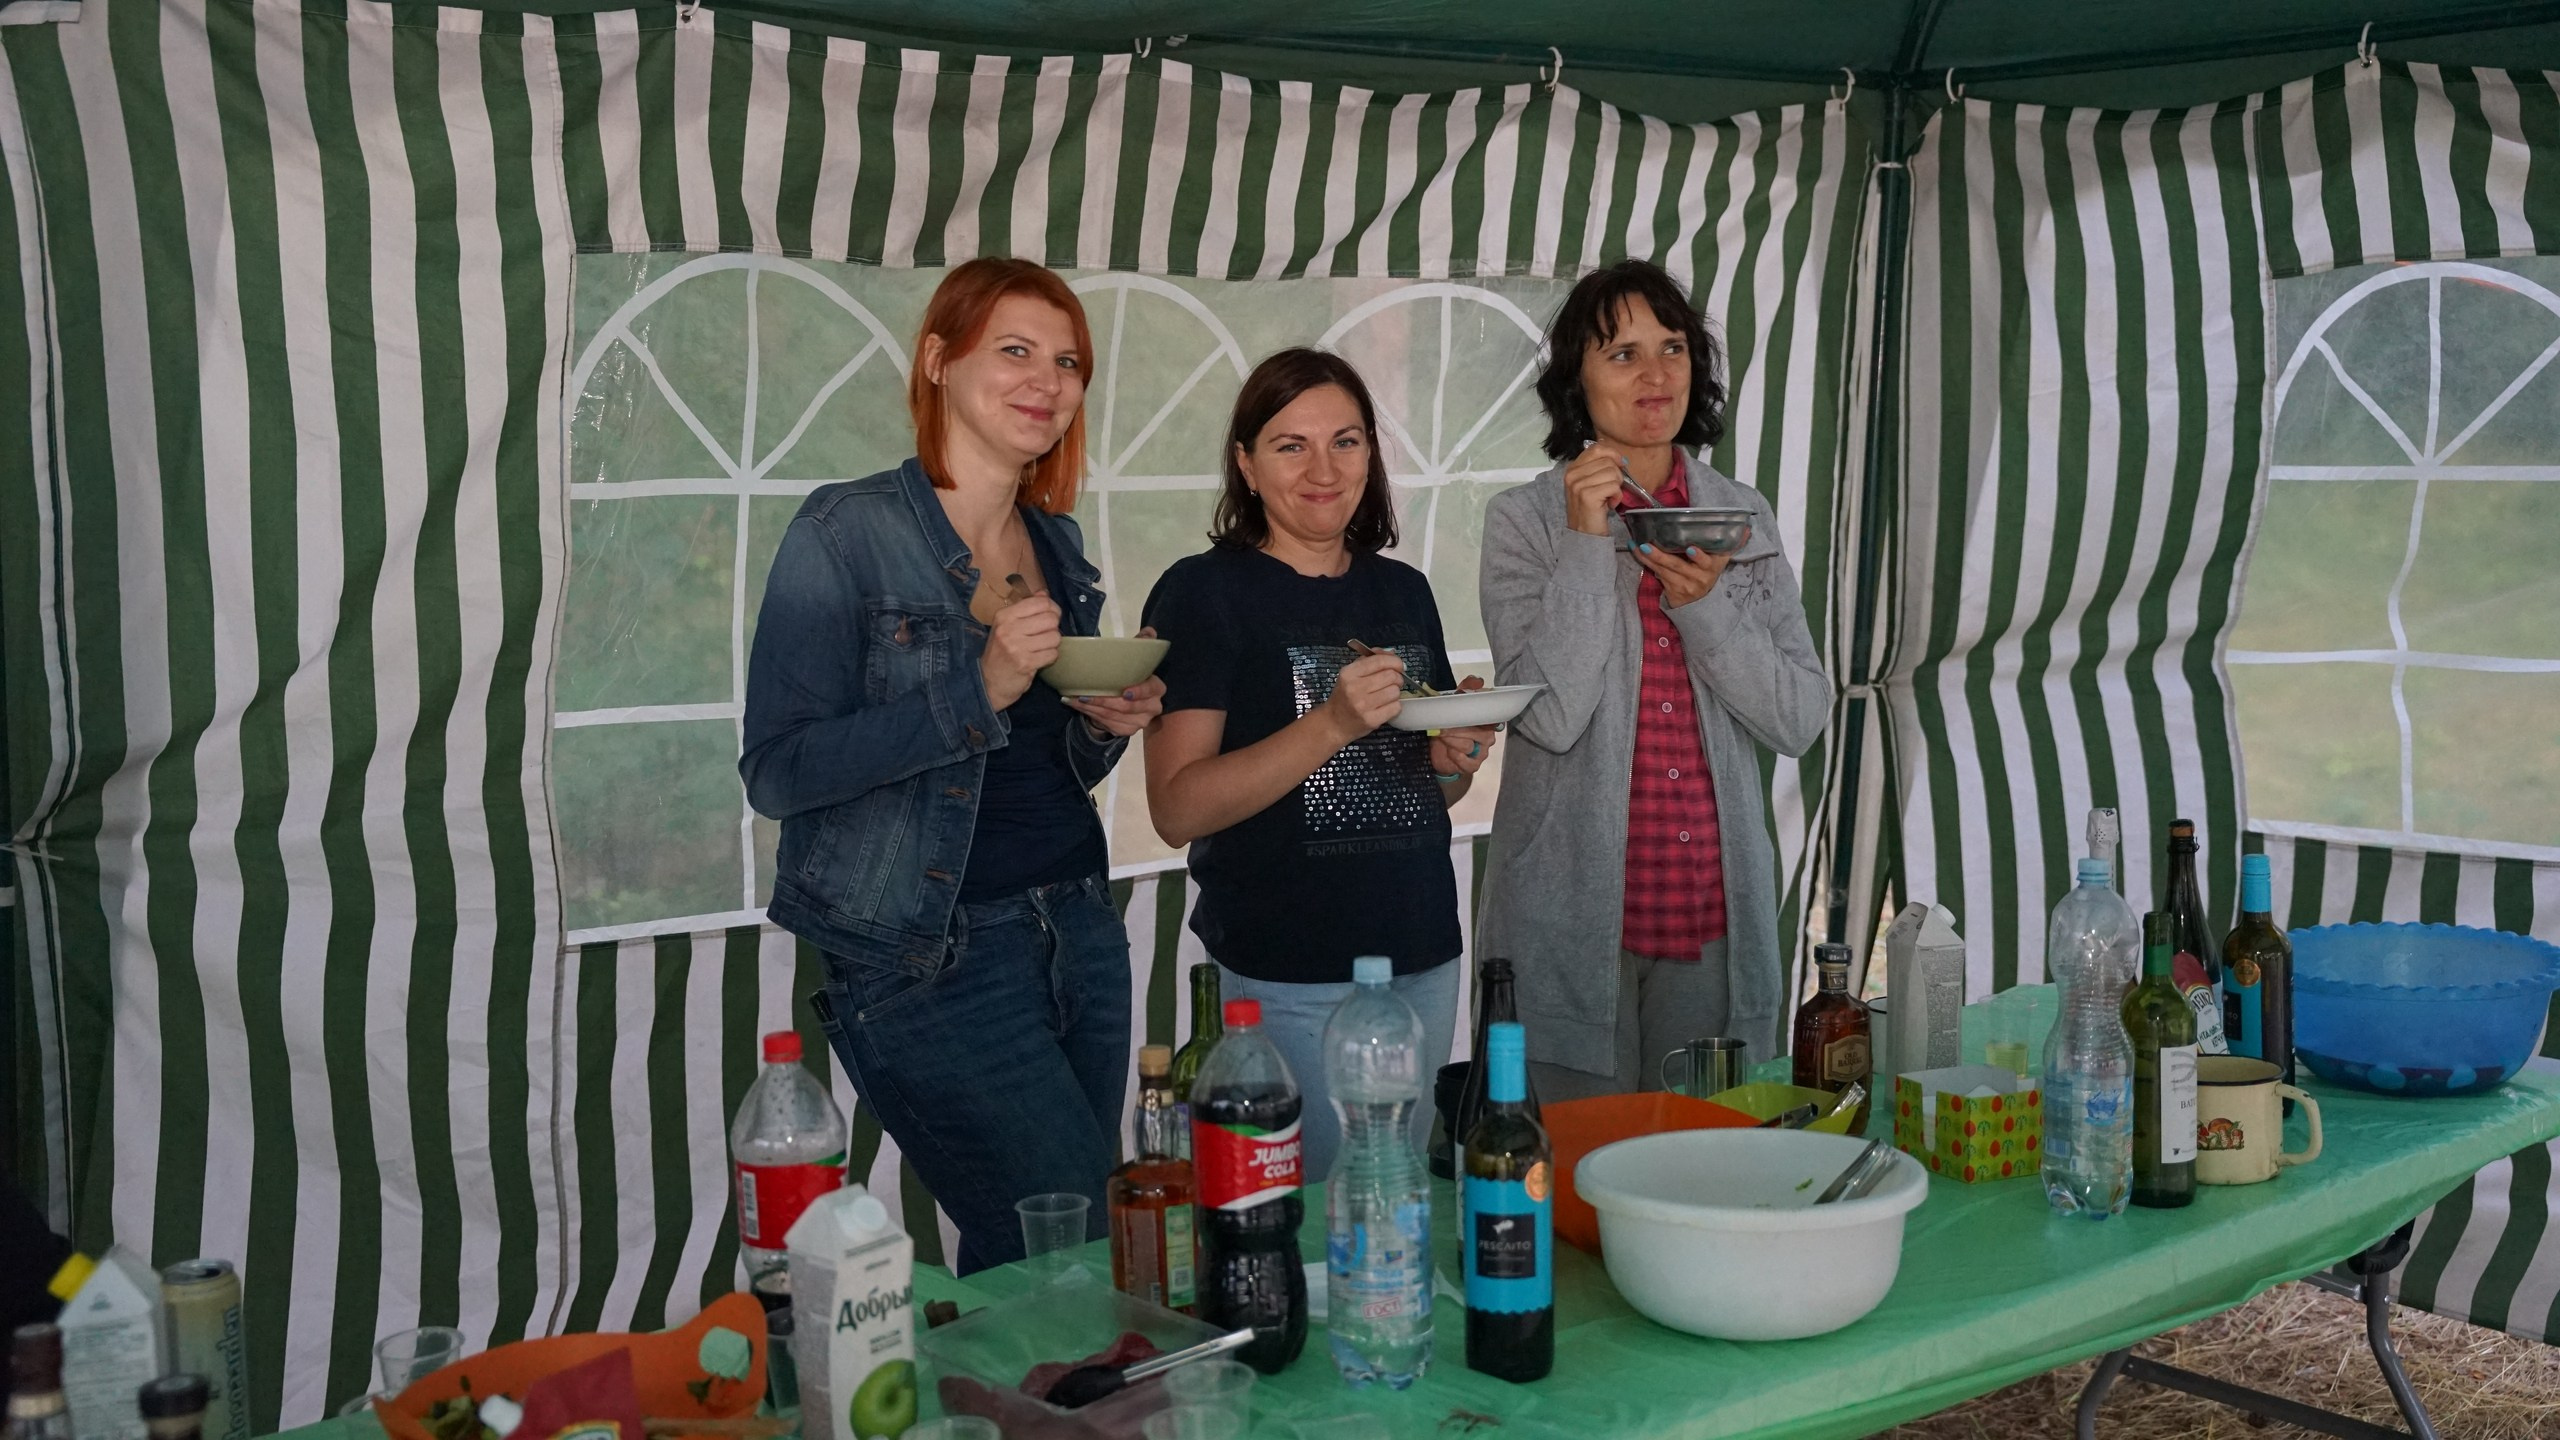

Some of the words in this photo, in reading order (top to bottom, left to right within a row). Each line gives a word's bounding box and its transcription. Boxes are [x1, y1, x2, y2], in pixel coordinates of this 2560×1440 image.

[1844, 1051, 1858, 1060] OLD
[1263, 1159, 1297, 1179] COLA
[1366, 1300, 1398, 1317] ГОСТ
